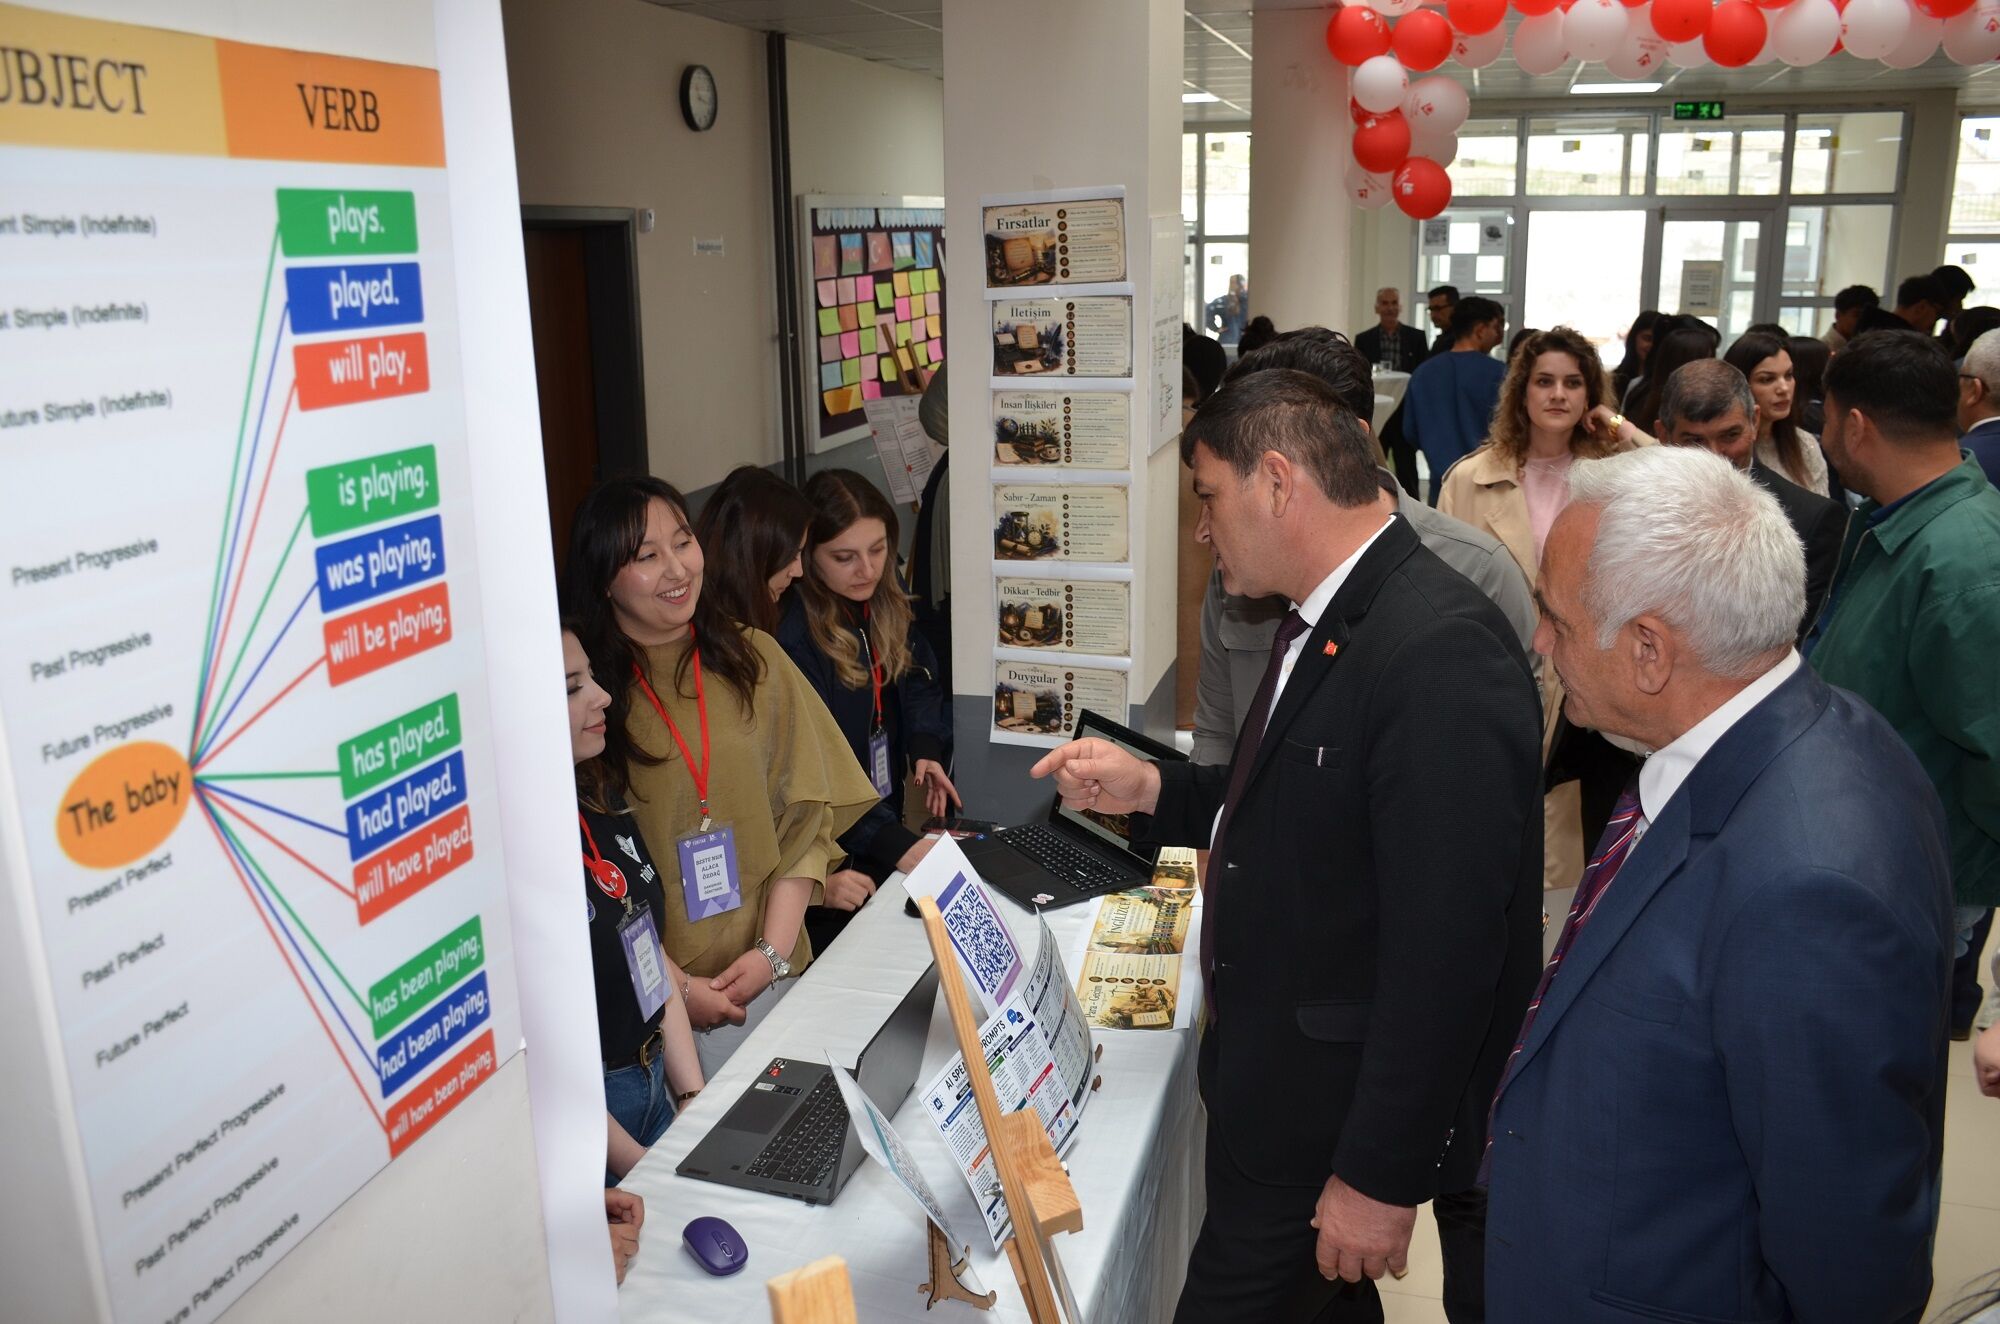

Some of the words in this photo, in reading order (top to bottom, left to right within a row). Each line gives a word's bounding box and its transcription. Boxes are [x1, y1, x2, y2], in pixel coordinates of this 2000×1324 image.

[0, 46, 147, 115] UBJECT
[297, 84, 380, 133] VERB
[22, 214, 76, 237] Simple
[81, 214, 156, 238] (Indefinite)
[327, 194, 385, 243] plays.
[996, 216, 1051, 231] Fırsatlar
[14, 307, 67, 330] Simple
[72, 301, 149, 328] (Indefinite)
[329, 267, 399, 319] played.
[1010, 306, 1051, 319] İletişim
[329, 346, 363, 385] will
[368, 341, 412, 389] play.
[0, 409, 39, 429] uture
[44, 399, 95, 423] Simple
[99, 381, 172, 418] (Indefinite)
[1000, 399, 1023, 409] İnsan
[1024, 398, 1057, 411] İlişkileri
[339, 472, 356, 508] is
[361, 460, 430, 513] playing.
[1003, 493, 1024, 503] Sabır
[1030, 493, 1057, 503] Zaman
[12, 557, 72, 587] Present
[75, 536, 159, 574] Progressive
[326, 552, 365, 592] was
[368, 534, 437, 583] playing.
[1003, 586, 1029, 597] Dikkat
[1036, 588, 1060, 597] Tedbir
[30, 655, 67, 683] Past
[70, 629, 153, 670] Progressive
[329, 625, 360, 665] will
[364, 616, 386, 652] be
[388, 601, 448, 651] playing.
[1008, 671, 1057, 685] Duygular
[41, 733, 91, 765] Future
[94, 701, 174, 745] Progressive
[351, 744, 386, 779] has
[390, 704, 450, 755] played.
[67, 798, 117, 838] The
[124, 771, 182, 814] baby
[357, 792, 393, 840] had
[396, 762, 456, 830] played.
[68, 876, 122, 915] Present
[125, 852, 174, 893] Perfect
[357, 865, 384, 906] will
[386, 852, 422, 888] have
[701, 863, 719, 872] ALACA
[82, 959, 116, 990] Past
[118, 932, 166, 971] Perfect
[372, 989, 398, 1021] has
[400, 966, 434, 1001] been
[434, 935, 480, 985] playing.
[95, 1031, 141, 1070] Future
[143, 1001, 190, 1039] Perfect
[380, 1043, 406, 1081] had
[408, 1022, 441, 1061] been
[442, 989, 488, 1034] playing.
[390, 1110, 409, 1142] will
[410, 1097, 434, 1127] have
[434, 1076, 459, 1106] been
[459, 1050, 494, 1088] playing.
[946, 1080, 952, 1090] AI
[952, 1062, 967, 1081] SPEA
[122, 1161, 175, 1210] Present
[176, 1131, 220, 1174] Perfect
[221, 1082, 287, 1140] Progressive
[135, 1244, 166, 1278] Past
[168, 1208, 212, 1251] Perfect
[213, 1156, 279, 1214] Progressive
[193, 1266, 235, 1310] Perfect
[236, 1212, 299, 1272] Progressive
